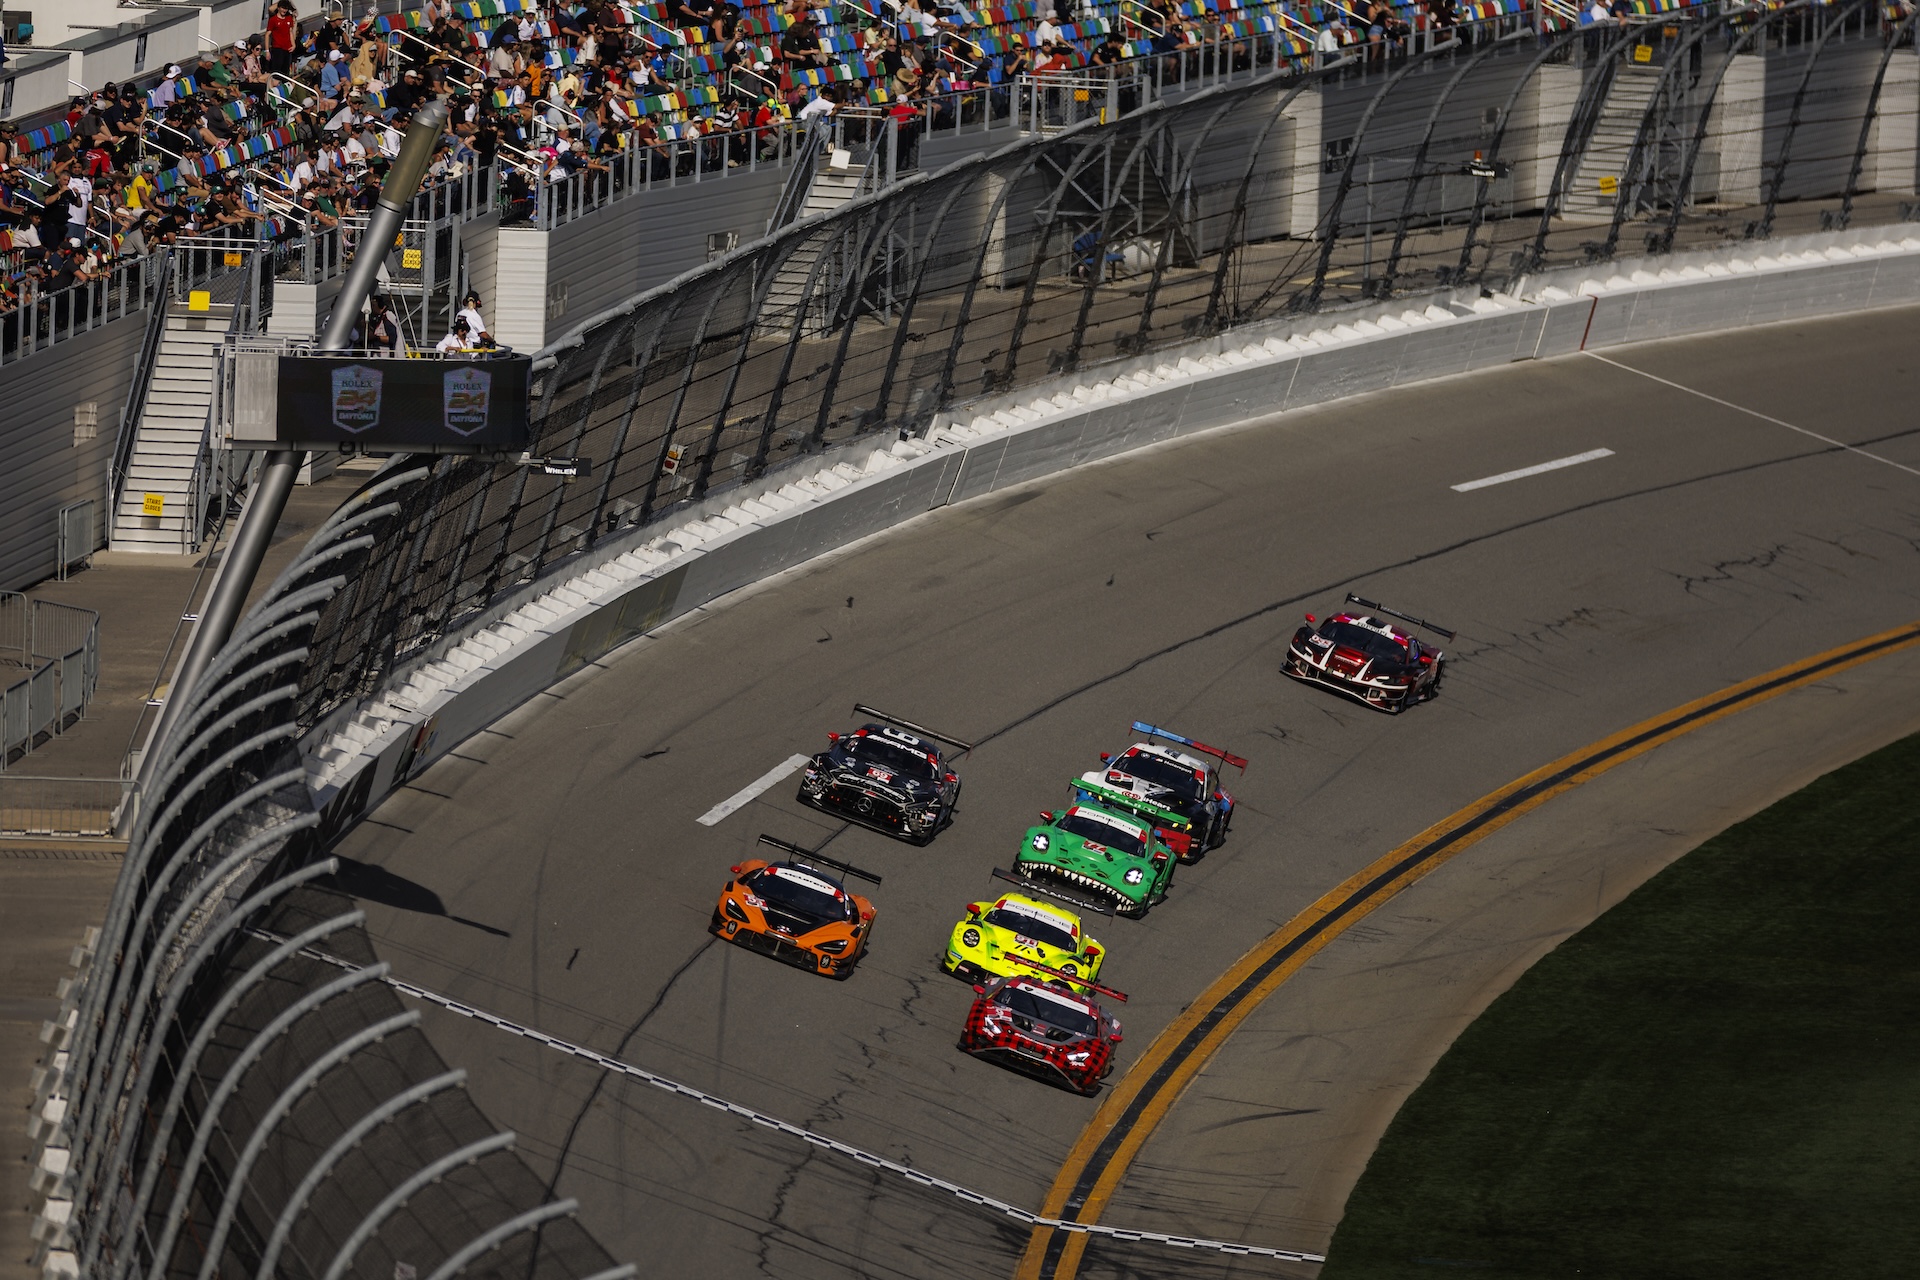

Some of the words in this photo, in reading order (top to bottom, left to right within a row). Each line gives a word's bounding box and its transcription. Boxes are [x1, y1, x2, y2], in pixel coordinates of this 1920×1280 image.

[453, 383, 482, 391] ROLEX
[338, 413, 374, 421] DAYTONA
[450, 415, 483, 424] DAYTONA
[145, 504, 161, 512] CLOSED
[1078, 809, 1140, 834] PORSCHE
[781, 871, 827, 889] McLaren
[1005, 903, 1071, 930] PORSCHE
